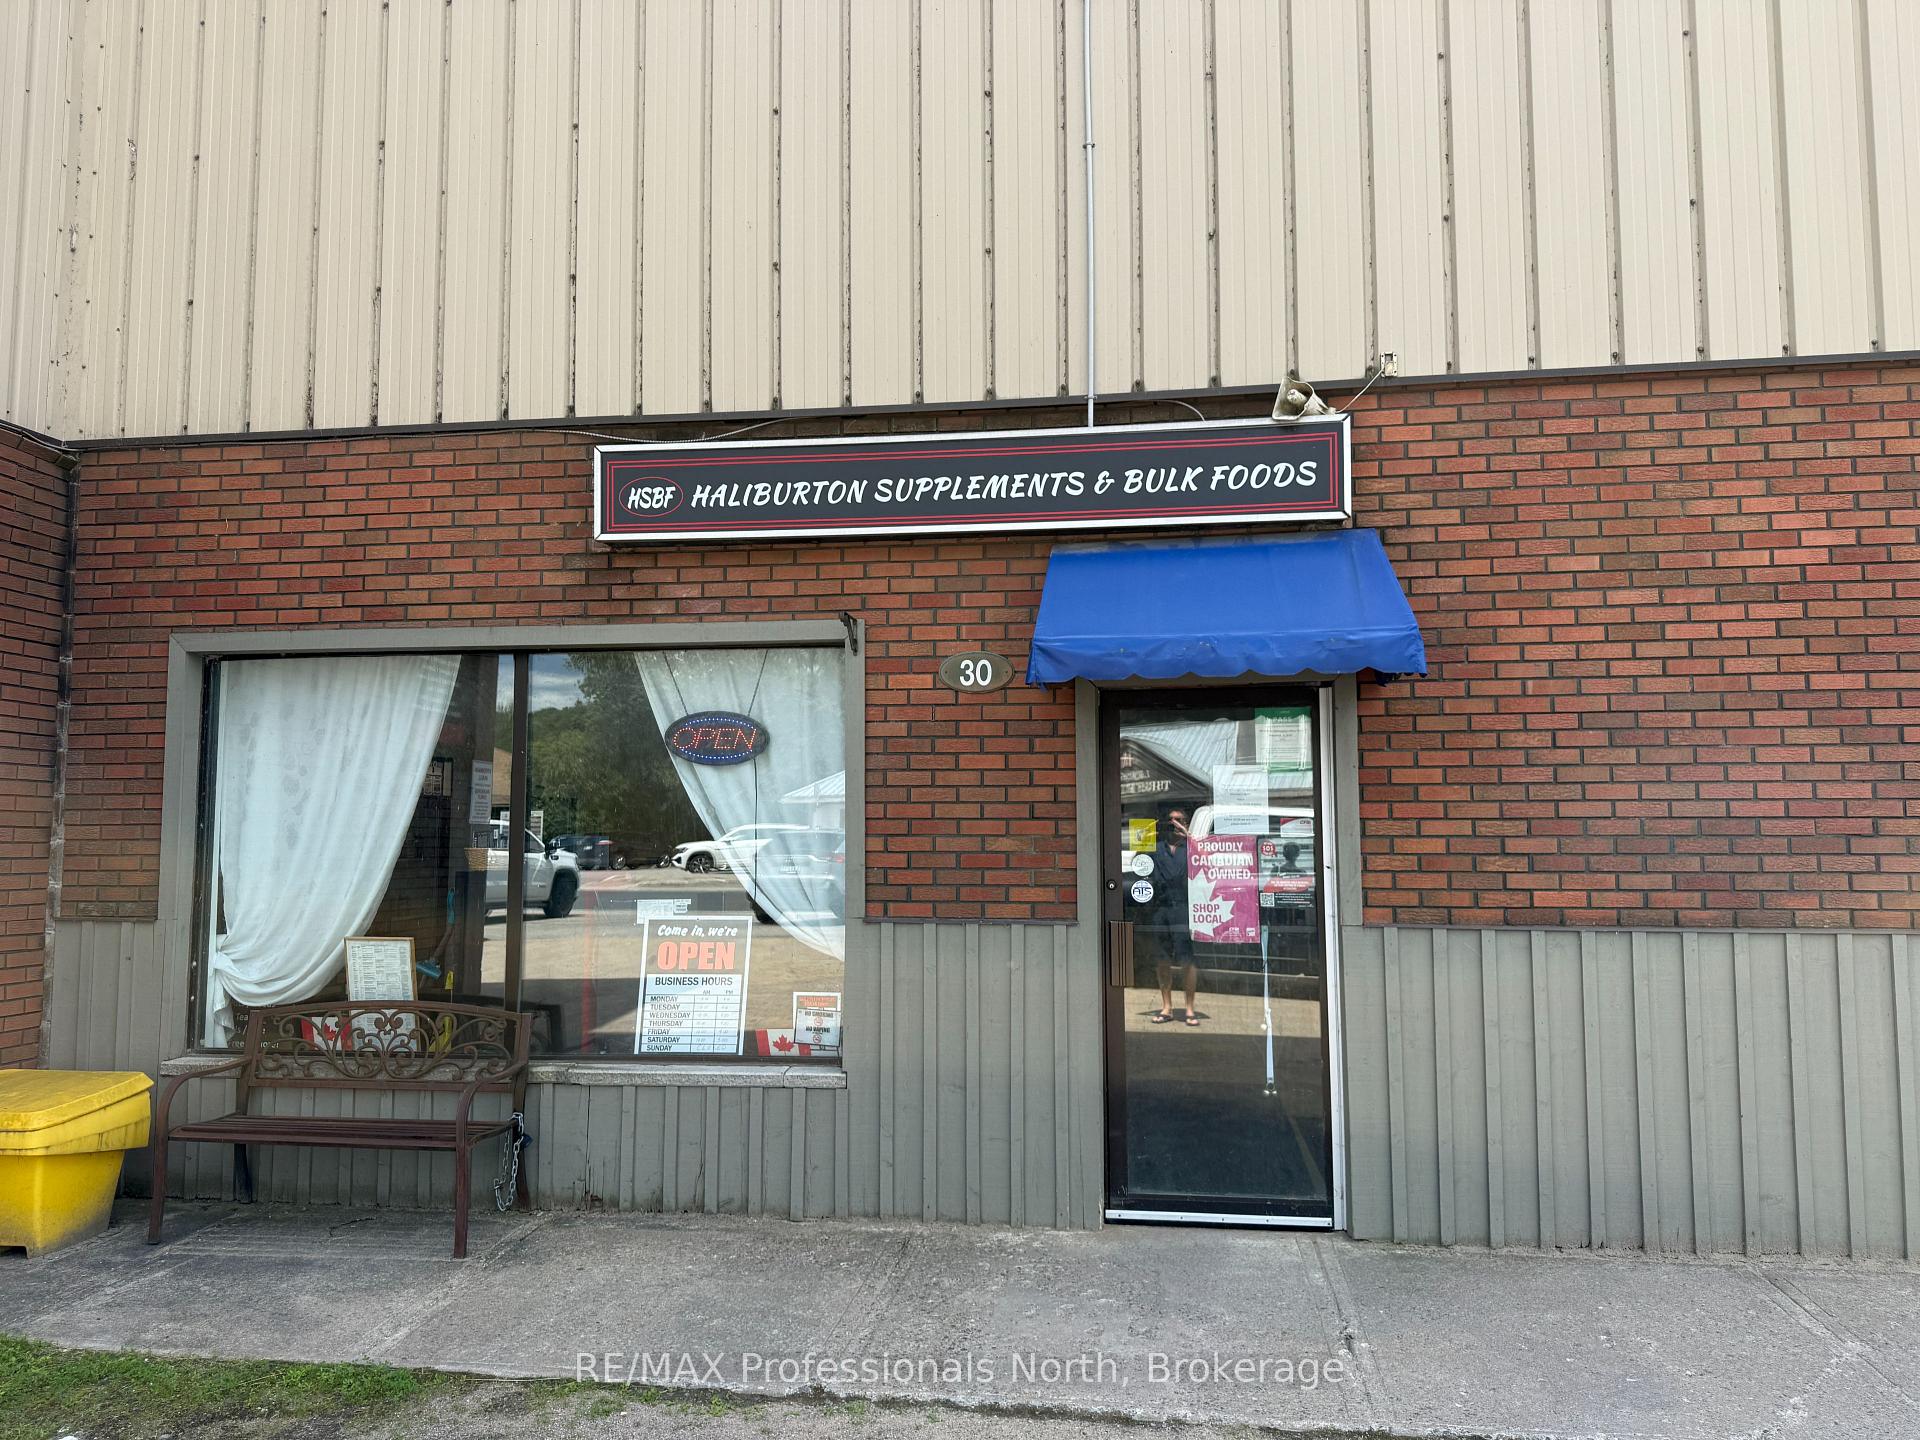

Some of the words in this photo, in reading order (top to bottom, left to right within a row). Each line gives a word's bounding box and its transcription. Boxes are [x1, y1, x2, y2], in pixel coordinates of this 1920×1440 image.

[690, 479, 868, 508] HALIBURTON
[873, 472, 1085, 502] SUPPLEMENTS
[1094, 471, 1115, 495] &
[1123, 466, 1204, 494] BULK
[1209, 461, 1318, 491] FOODS
[627, 486, 676, 510] HSBF
[959, 659, 992, 686] 30
[672, 727, 757, 749] OPEN
[1197, 841, 1243, 852] PROUDLY
[1191, 854, 1254, 866] CANADIAN
[1207, 868, 1255, 880] OWNED.
[1132, 887, 1152, 895] ATS
[1192, 903, 1220, 913] SHOP
[1192, 914, 1223, 924] LOCAL
[657, 924, 688, 937] Come
[690, 924, 705, 937] in,
[707, 925, 738, 937] we're
[657, 941, 736, 970] OPEN
[655, 976, 699, 986] BUSINESS
[701, 976, 733, 986] HOURS
[650, 1003, 680, 1011] TUESDAY
[649, 1011, 691, 1019] WEDNESDAY
